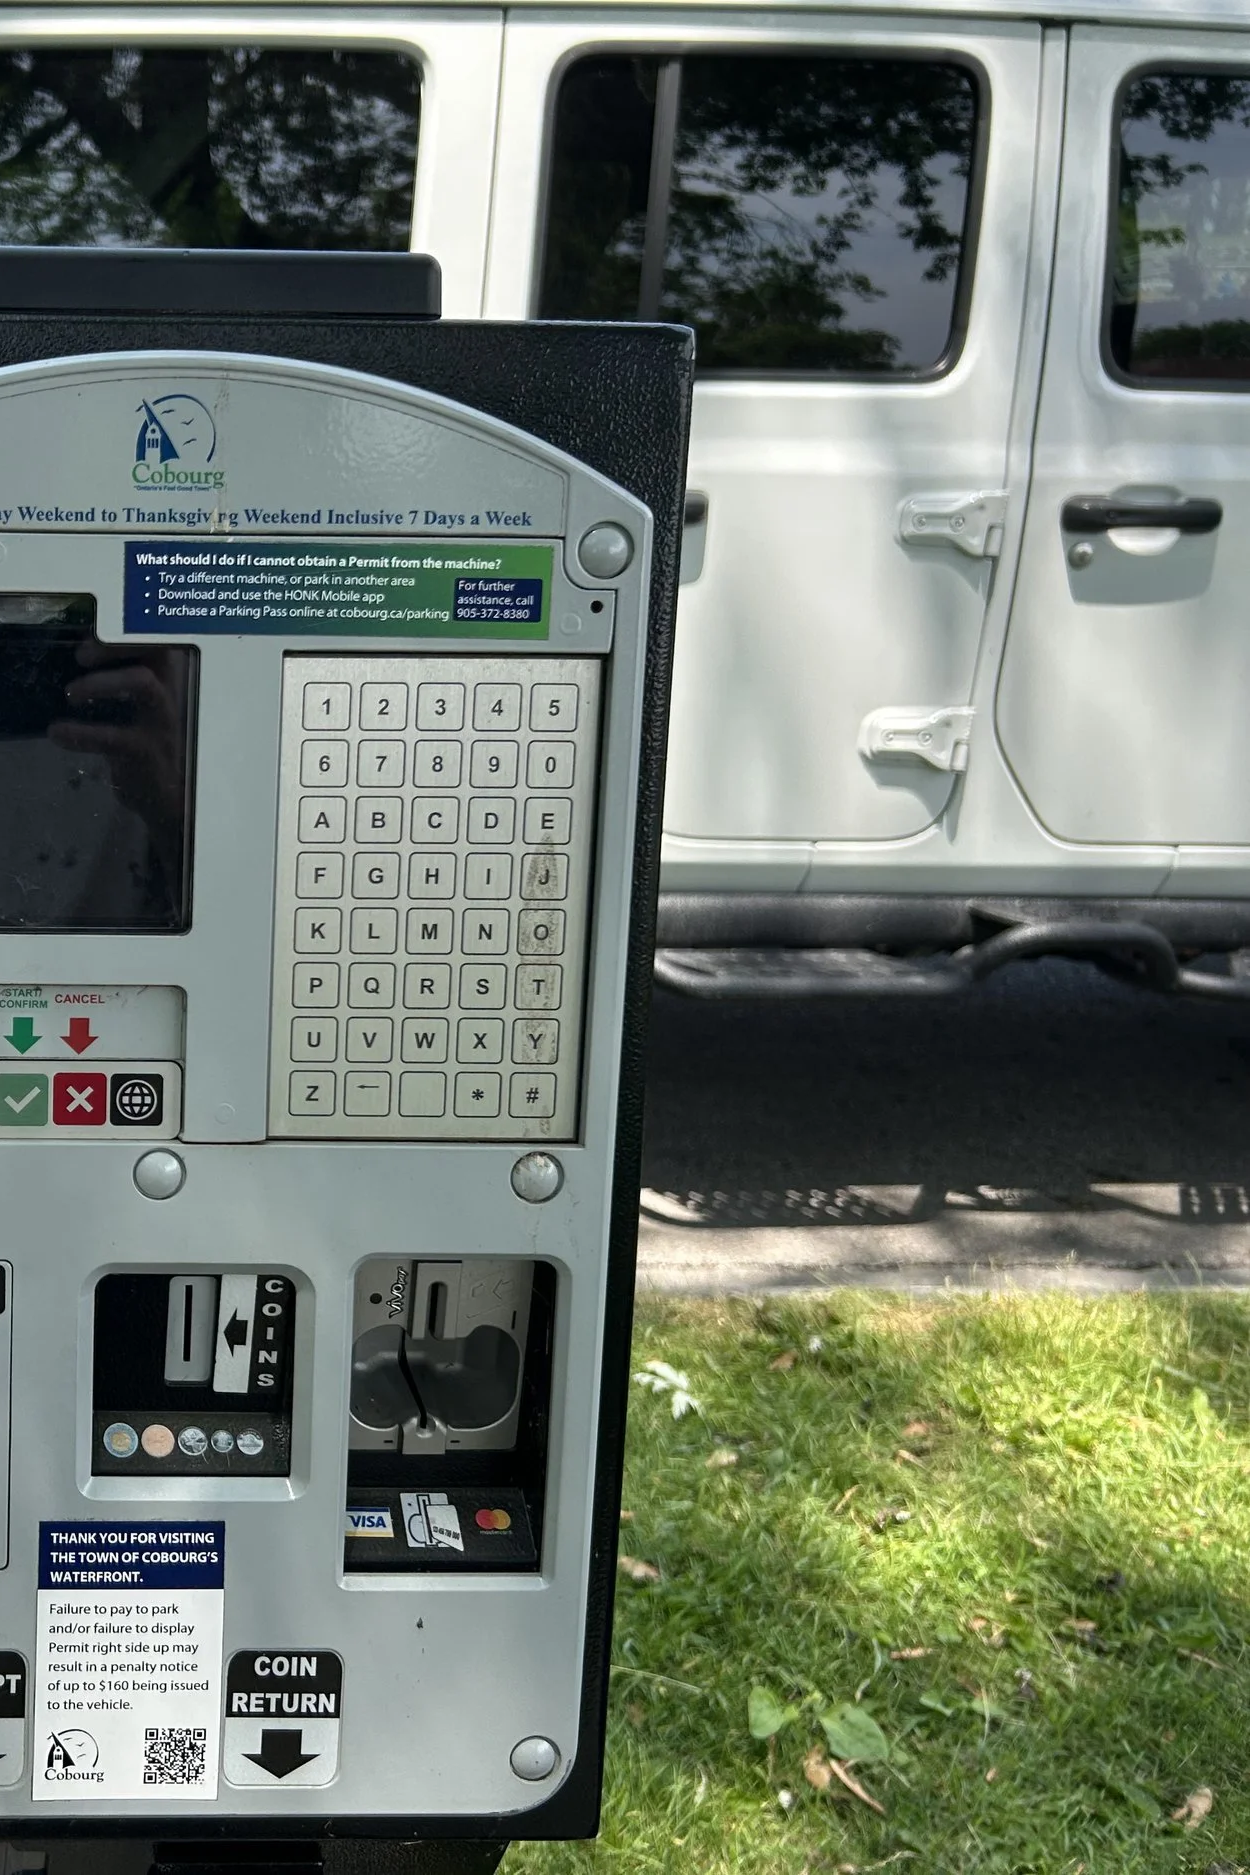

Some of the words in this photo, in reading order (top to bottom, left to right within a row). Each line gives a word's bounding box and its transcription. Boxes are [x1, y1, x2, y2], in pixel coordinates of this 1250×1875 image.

[132, 463, 224, 489] Cobourg
[18, 506, 95, 523] Weekend
[101, 509, 117, 523] to
[122, 508, 238, 527] Thanksgivng
[245, 509, 321, 525] Weekend
[327, 509, 403, 526] Inclusive
[409, 511, 418, 526] 7
[424, 511, 464, 529] Days
[470, 515, 479, 526] a
[485, 511, 532, 527] Week
[136, 554, 167, 566] What
[169, 554, 211, 566] should
[213, 554, 217, 566] I
[219, 554, 235, 566] do
[237, 554, 246, 566] if
[247, 555, 251, 566] I
[253, 556, 295, 567] cannot
[297, 555, 337, 567] obtain
[339, 558, 346, 567] a
[349, 557, 389, 568] Permit
[391, 557, 420, 569] from
[423, 558, 442, 569] the
[444, 559, 502, 570] machine?
[158, 572, 175, 586] Try
[178, 575, 185, 584] a
[187, 572, 235, 584] different
[237, 573, 288, 586] machine,
[289, 576, 301, 585] or
[304, 573, 329, 587] park
[331, 574, 342, 585] in
[344, 574, 389, 586] another
[391, 578, 415, 587] area
[458, 580, 476, 591] For
[478, 581, 516, 592] further
[158, 589, 215, 601] Download
[217, 589, 239, 601] and
[241, 592, 261, 601] use
[263, 589, 282, 601] the
[284, 590, 319, 601] HONK
[321, 590, 360, 602] Mobile
[362, 593, 385, 604] app
[457, 594, 514, 606] assistance,
[515, 595, 534, 606] call
[158, 605, 208, 617] Purchase
[209, 608, 217, 617] a
[218, 605, 260, 619] Parking
[263, 606, 287, 617] Pass
[289, 606, 325, 618] online
[327, 608, 338, 618] at
[339, 608, 449, 622] cobourg.ca/parking
[457, 608, 530, 620] 905-372-8380
[322, 699, 330, 715] 1
[378, 699, 389, 715] 2
[435, 699, 446, 715] 3
[491, 699, 503, 716] 4
[549, 700, 559, 716] 5
[319, 756, 330, 772] 6
[376, 756, 387, 772] 7
[432, 756, 443, 772] 8
[489, 756, 499, 772] 9
[545, 757, 556, 773] 0
[314, 812, 329, 828] A
[372, 812, 385, 828] B
[428, 812, 442, 828] C
[485, 813, 498, 829] D
[542, 813, 554, 829] E
[315, 868, 326, 883] F
[368, 868, 383, 884] G
[426, 868, 439, 884] H
[486, 869, 490, 884] I
[538, 869, 549, 885] J
[311, 923, 325, 939] K
[369, 923, 380, 939] L
[422, 924, 437, 939] M
[479, 924, 492, 940] N
[533, 924, 549, 940] O
[310, 978, 322, 993] P
[364, 977, 379, 994] Q
[421, 979, 434, 994] R
[476, 979, 489, 994] S
[533, 980, 545, 994] T
[0, 999, 48, 1009] CONFIRM
[54, 994, 105, 1004] CANCEL
[308, 1032, 320, 1047] U
[363, 1033, 377, 1048] V
[415, 1033, 435, 1048] W
[473, 1033, 486, 1049] X
[529, 1034, 543, 1049] Y
[306, 1086, 318, 1101] Z
[256, 1279, 284, 1387] COINS
[350, 1515, 387, 1528] VISA
[50, 1532, 97, 1544] THANK
[99, 1532, 128, 1544] YOU
[130, 1532, 157, 1544] FOR
[158, 1532, 215, 1544] VISITING
[50, 1552, 76, 1563] THE
[78, 1552, 119, 1563] TOWN
[121, 1552, 139, 1563] OF
[50, 1571, 144, 1583] WATERFRONT.
[49, 1603, 91, 1615] Failure
[94, 1605, 107, 1615] to
[110, 1606, 133, 1617] pay
[136, 1605, 149, 1615] to
[151, 1603, 179, 1617] park
[48, 1623, 91, 1634] and/or
[93, 1623, 133, 1634] failure
[135, 1624, 148, 1634] to
[151, 1623, 195, 1636] display
[49, 1642, 90, 1653] Permit
[92, 1642, 122, 1655] right
[124, 1642, 150, 1653] side
[153, 1645, 169, 1656] up
[172, 1645, 199, 1655] may
[48, 1661, 82, 1672] result
[86, 1661, 97, 1672] in
[100, 1664, 107, 1672] a
[110, 1661, 157, 1674] penalty
[159, 1661, 198, 1672] notice
[254, 1656, 317, 1677] COIN
[47, 1680, 61, 1691] of
[63, 1683, 80, 1693] up
[83, 1681, 96, 1691] to
[99, 1680, 129, 1692] $160
[132, 1680, 167, 1693] being
[170, 1680, 209, 1691] issued
[47, 1700, 60, 1710] to
[63, 1699, 84, 1710] the
[86, 1699, 133, 1710] vehicle.
[231, 1692, 336, 1714] RETURN
[44, 1768, 105, 1783] Cobourg
